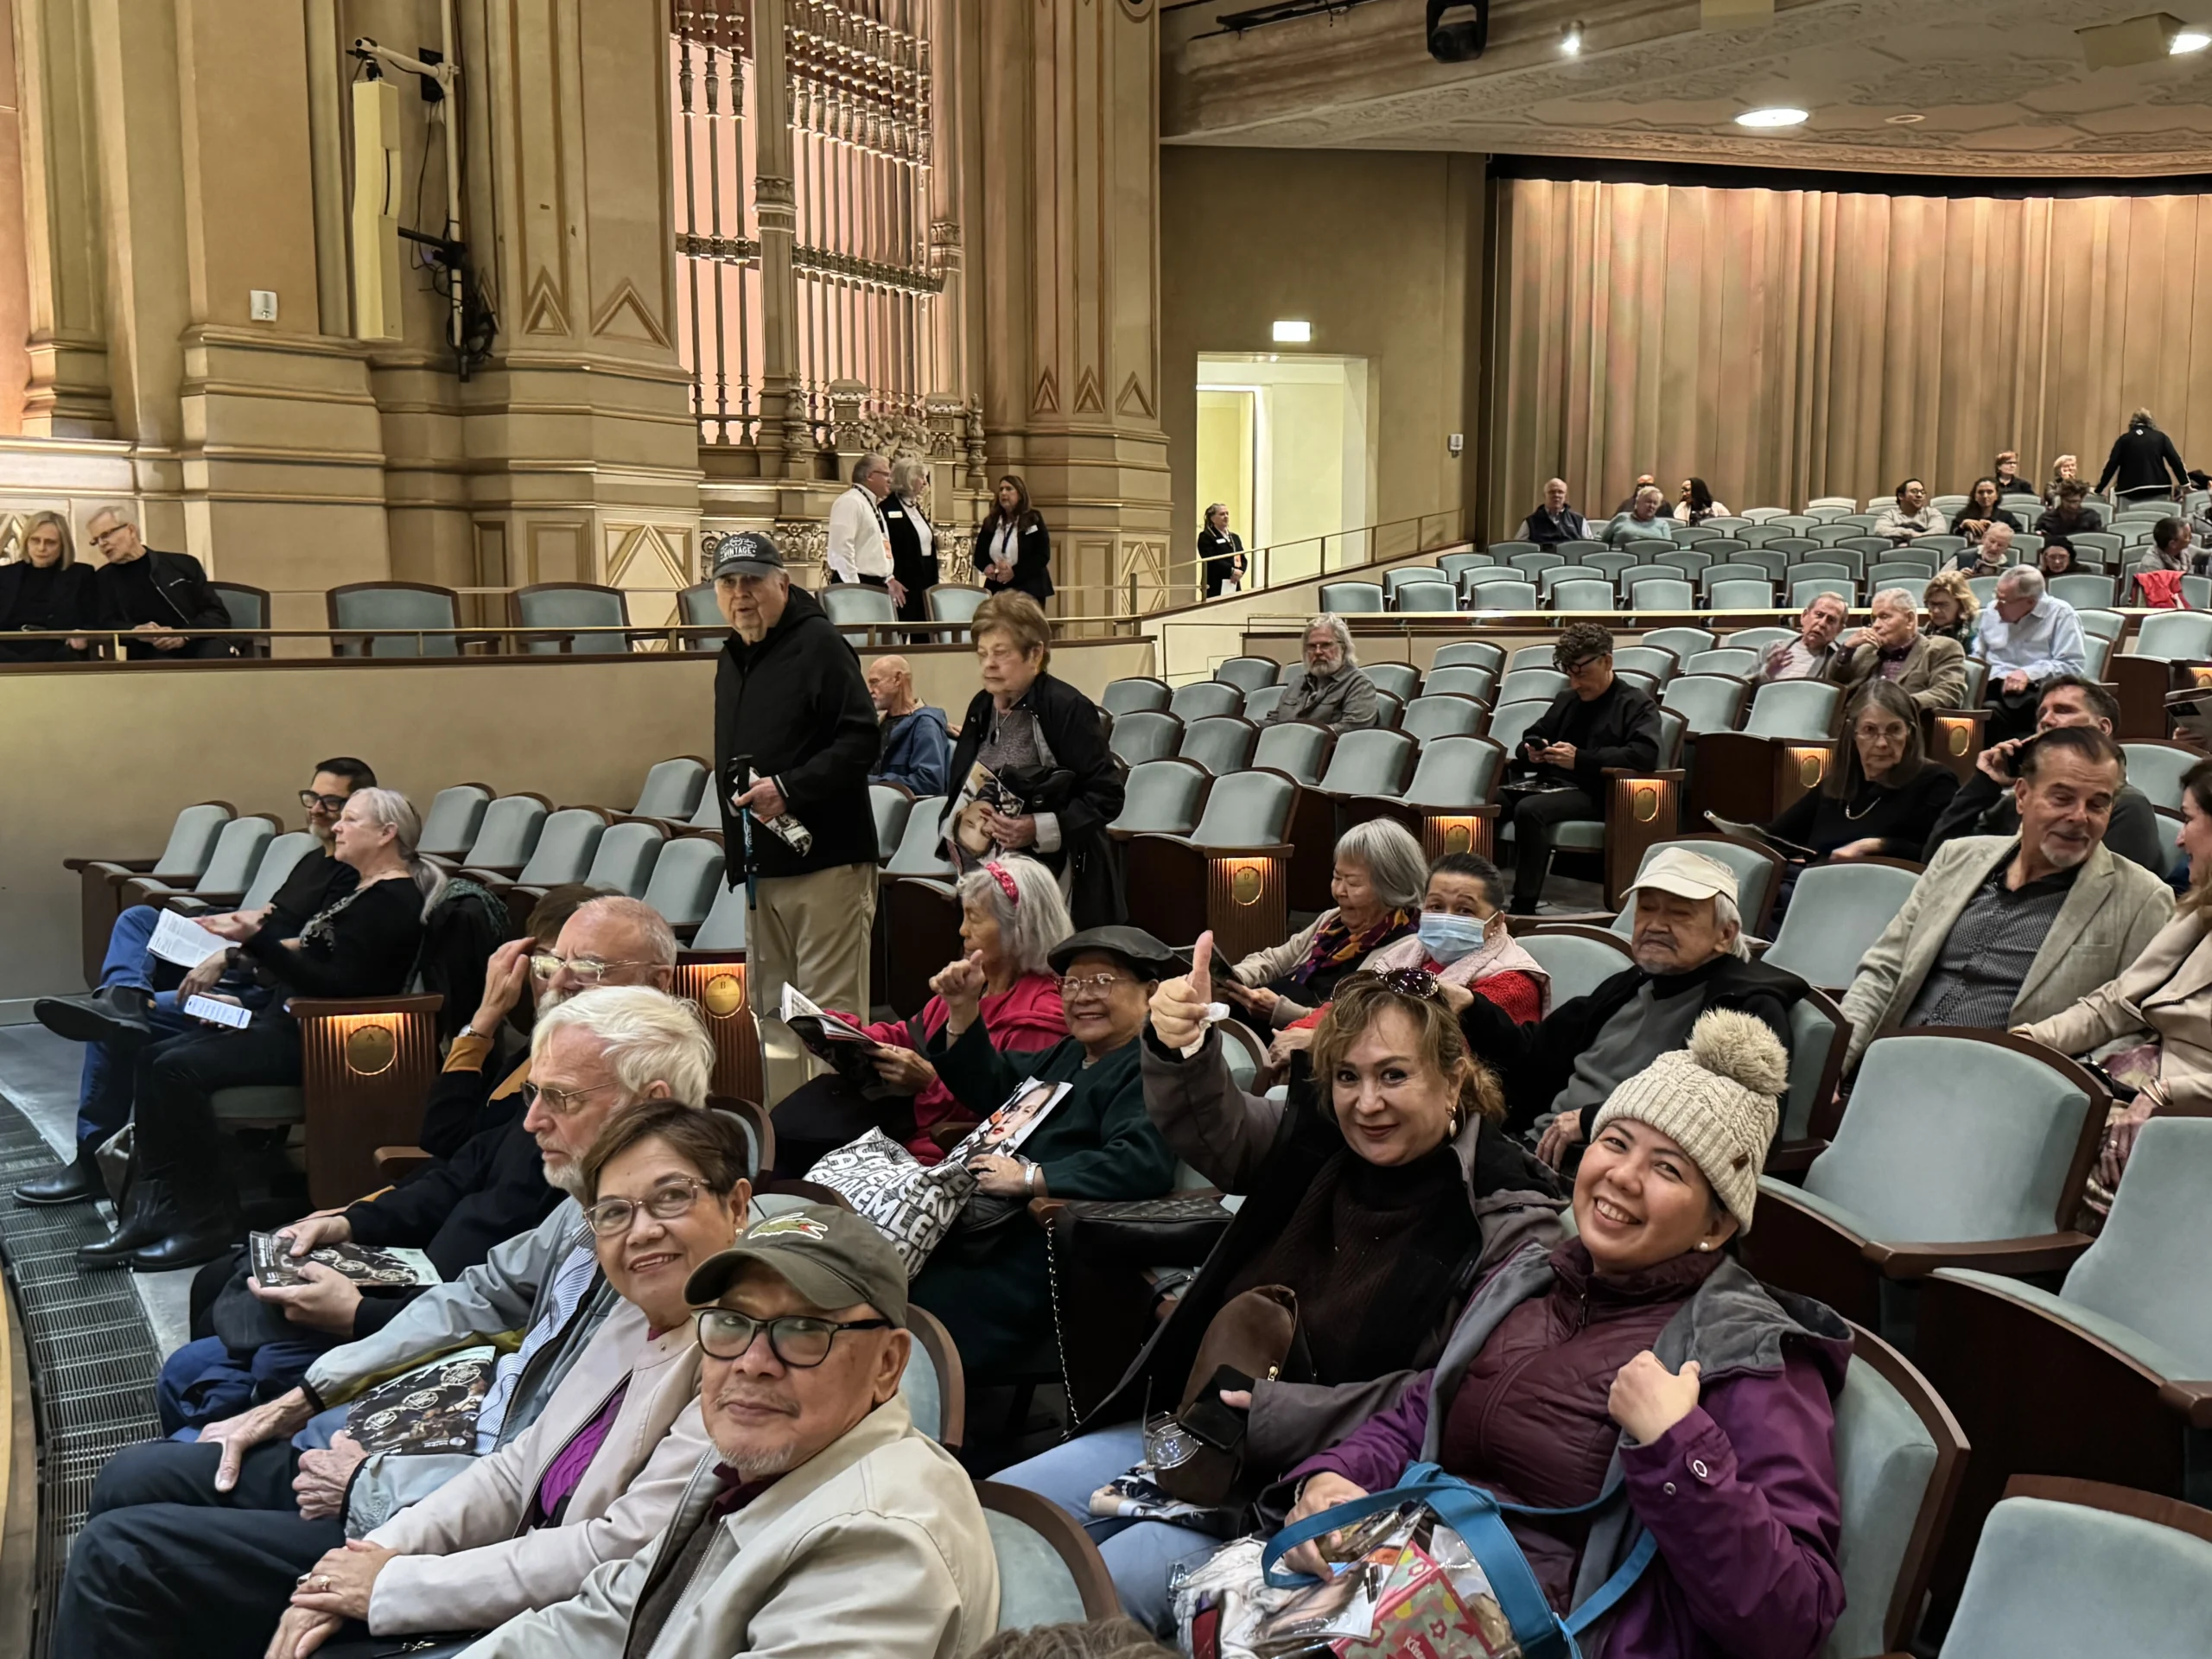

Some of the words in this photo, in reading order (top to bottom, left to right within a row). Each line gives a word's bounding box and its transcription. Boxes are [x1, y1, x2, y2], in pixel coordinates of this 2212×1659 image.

[722, 546, 752, 558] VINTAGE
[720, 981, 727, 989] B
[365, 1033, 375, 1042] A
